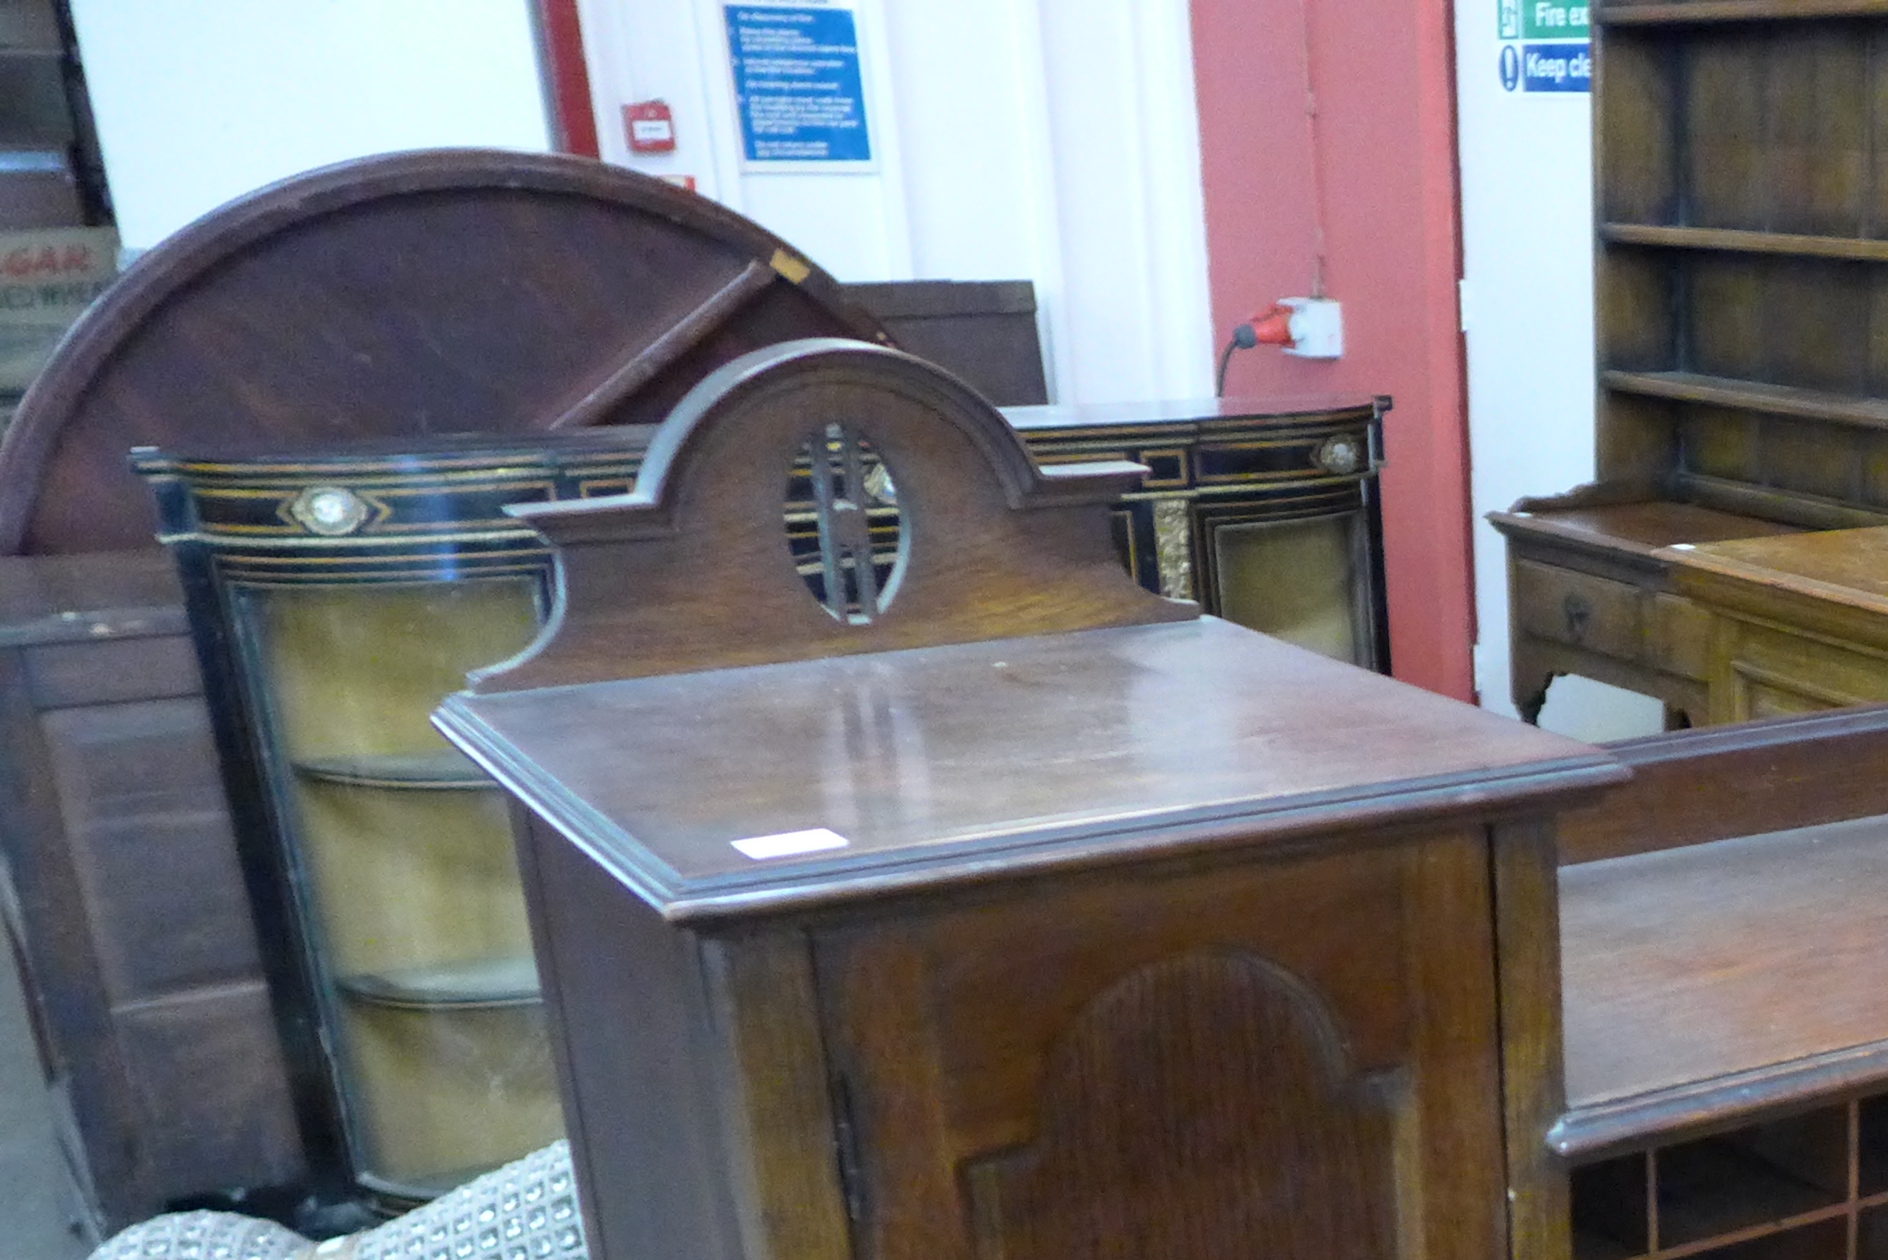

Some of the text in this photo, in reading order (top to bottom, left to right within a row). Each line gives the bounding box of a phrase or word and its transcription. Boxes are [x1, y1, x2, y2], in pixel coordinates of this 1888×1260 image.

[1535, 2, 1589, 27] Fire ex
[1525, 53, 1592, 83] Keep cle
